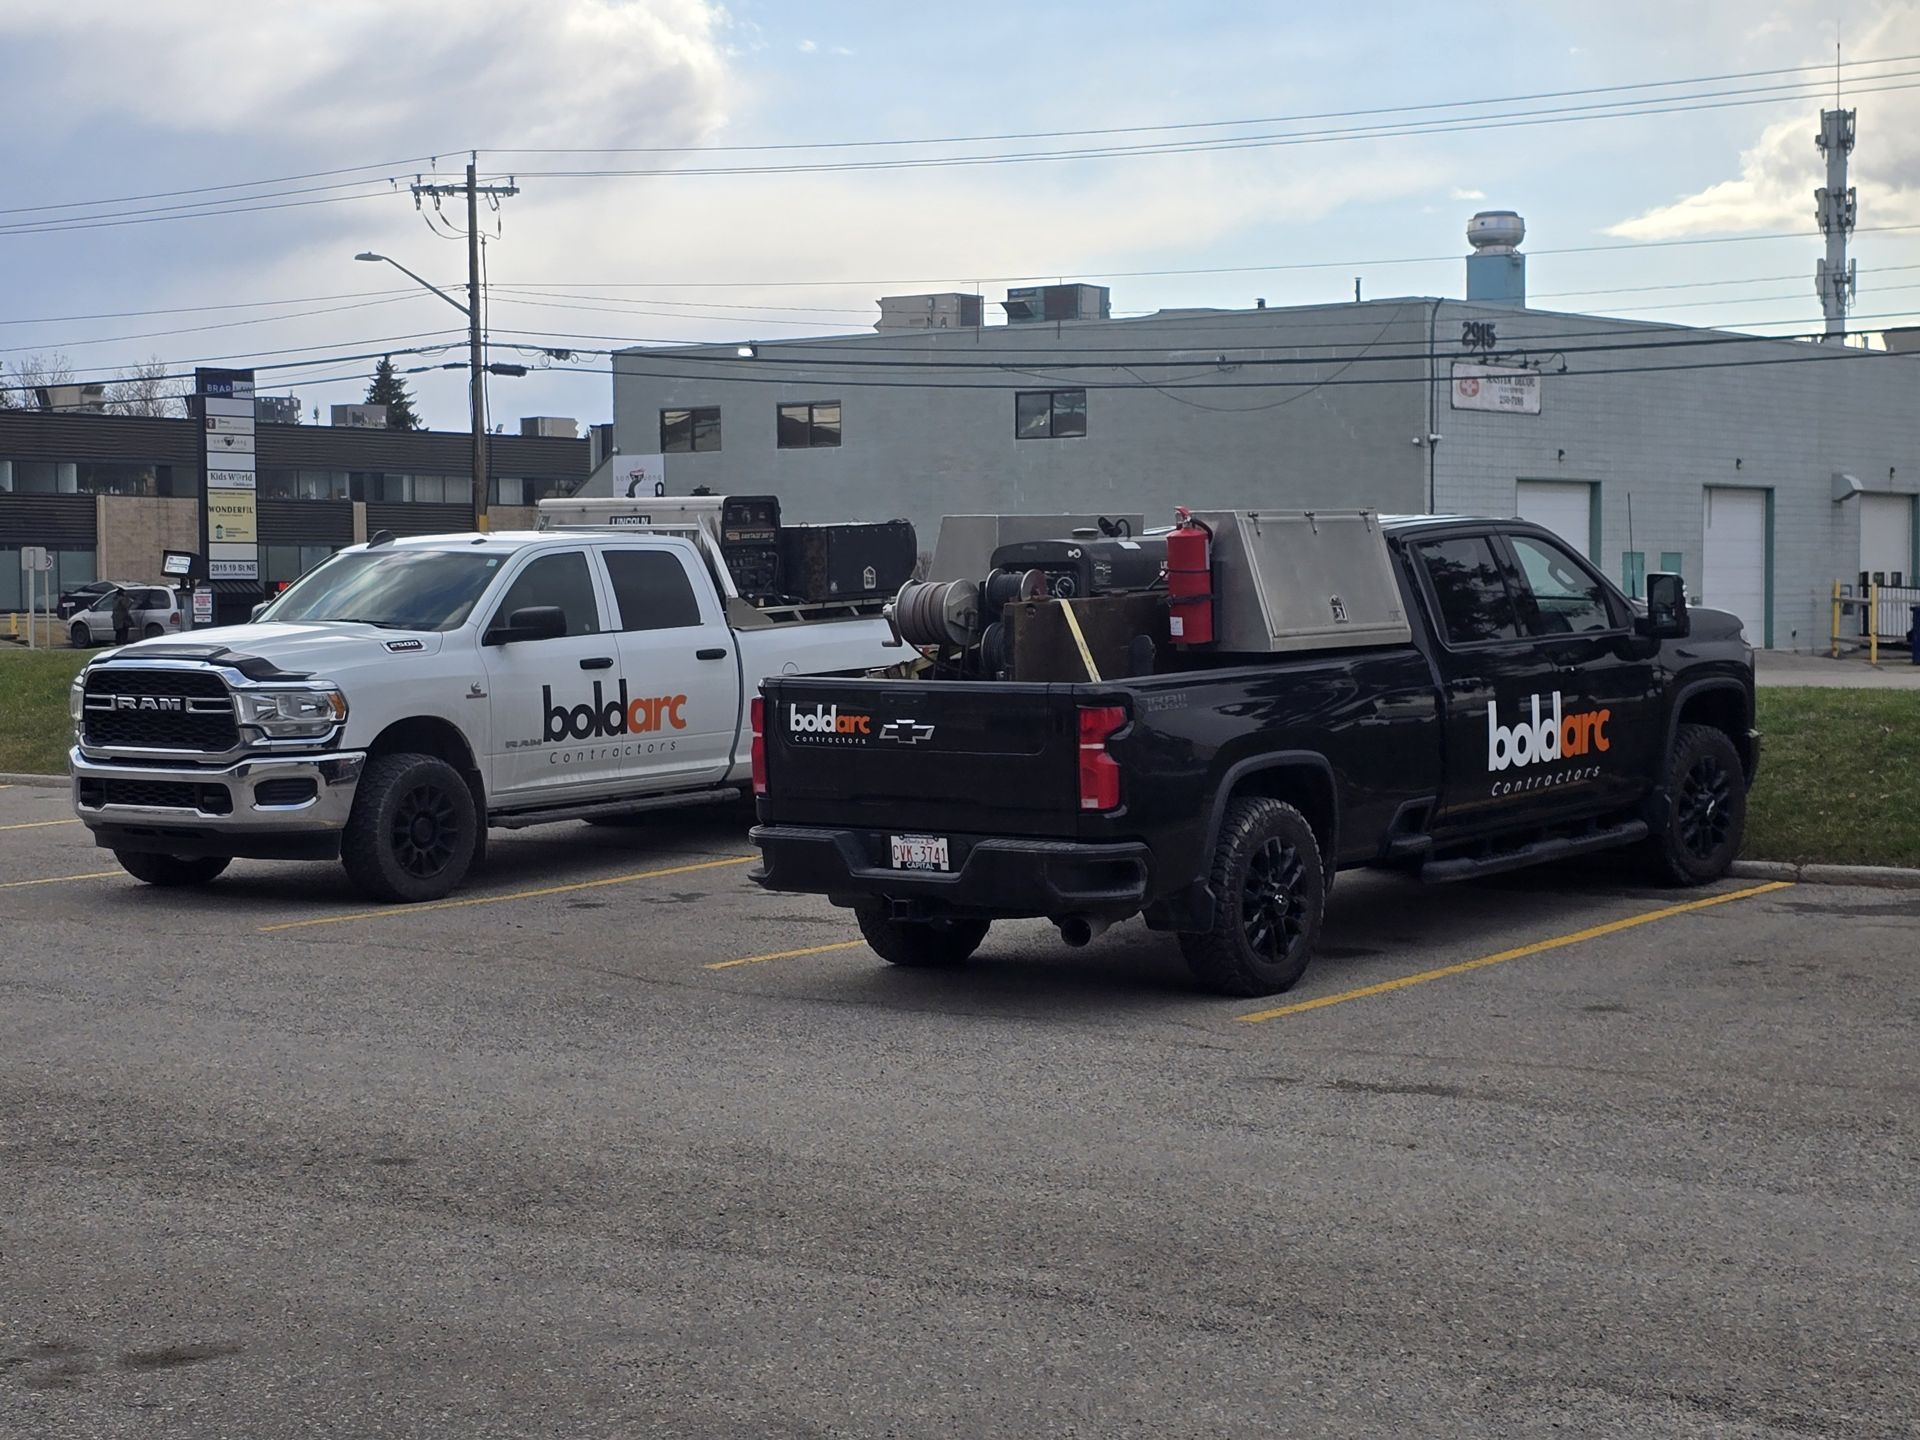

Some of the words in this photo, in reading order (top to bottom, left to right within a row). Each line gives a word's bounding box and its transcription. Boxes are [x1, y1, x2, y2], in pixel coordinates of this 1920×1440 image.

[1462, 322, 1496, 349] 2915
[210, 472, 227, 481] Kids
[611, 517, 649, 525] LINCOLN
[211, 563, 228, 572] 2915
[229, 563, 237, 572] 19
[238, 564, 245, 572] St
[247, 564, 256, 573] NE
[117, 697, 181, 710] RAM
[542, 678, 688, 743] boldarc
[790, 703, 871, 734] boldarc
[795, 734, 867, 745] Contractors
[1487, 690, 1611, 772] boldarc
[550, 740, 677, 764] Contractors
[1491, 765, 1601, 797] Contractors
[892, 844, 949, 864] CVK-3741
